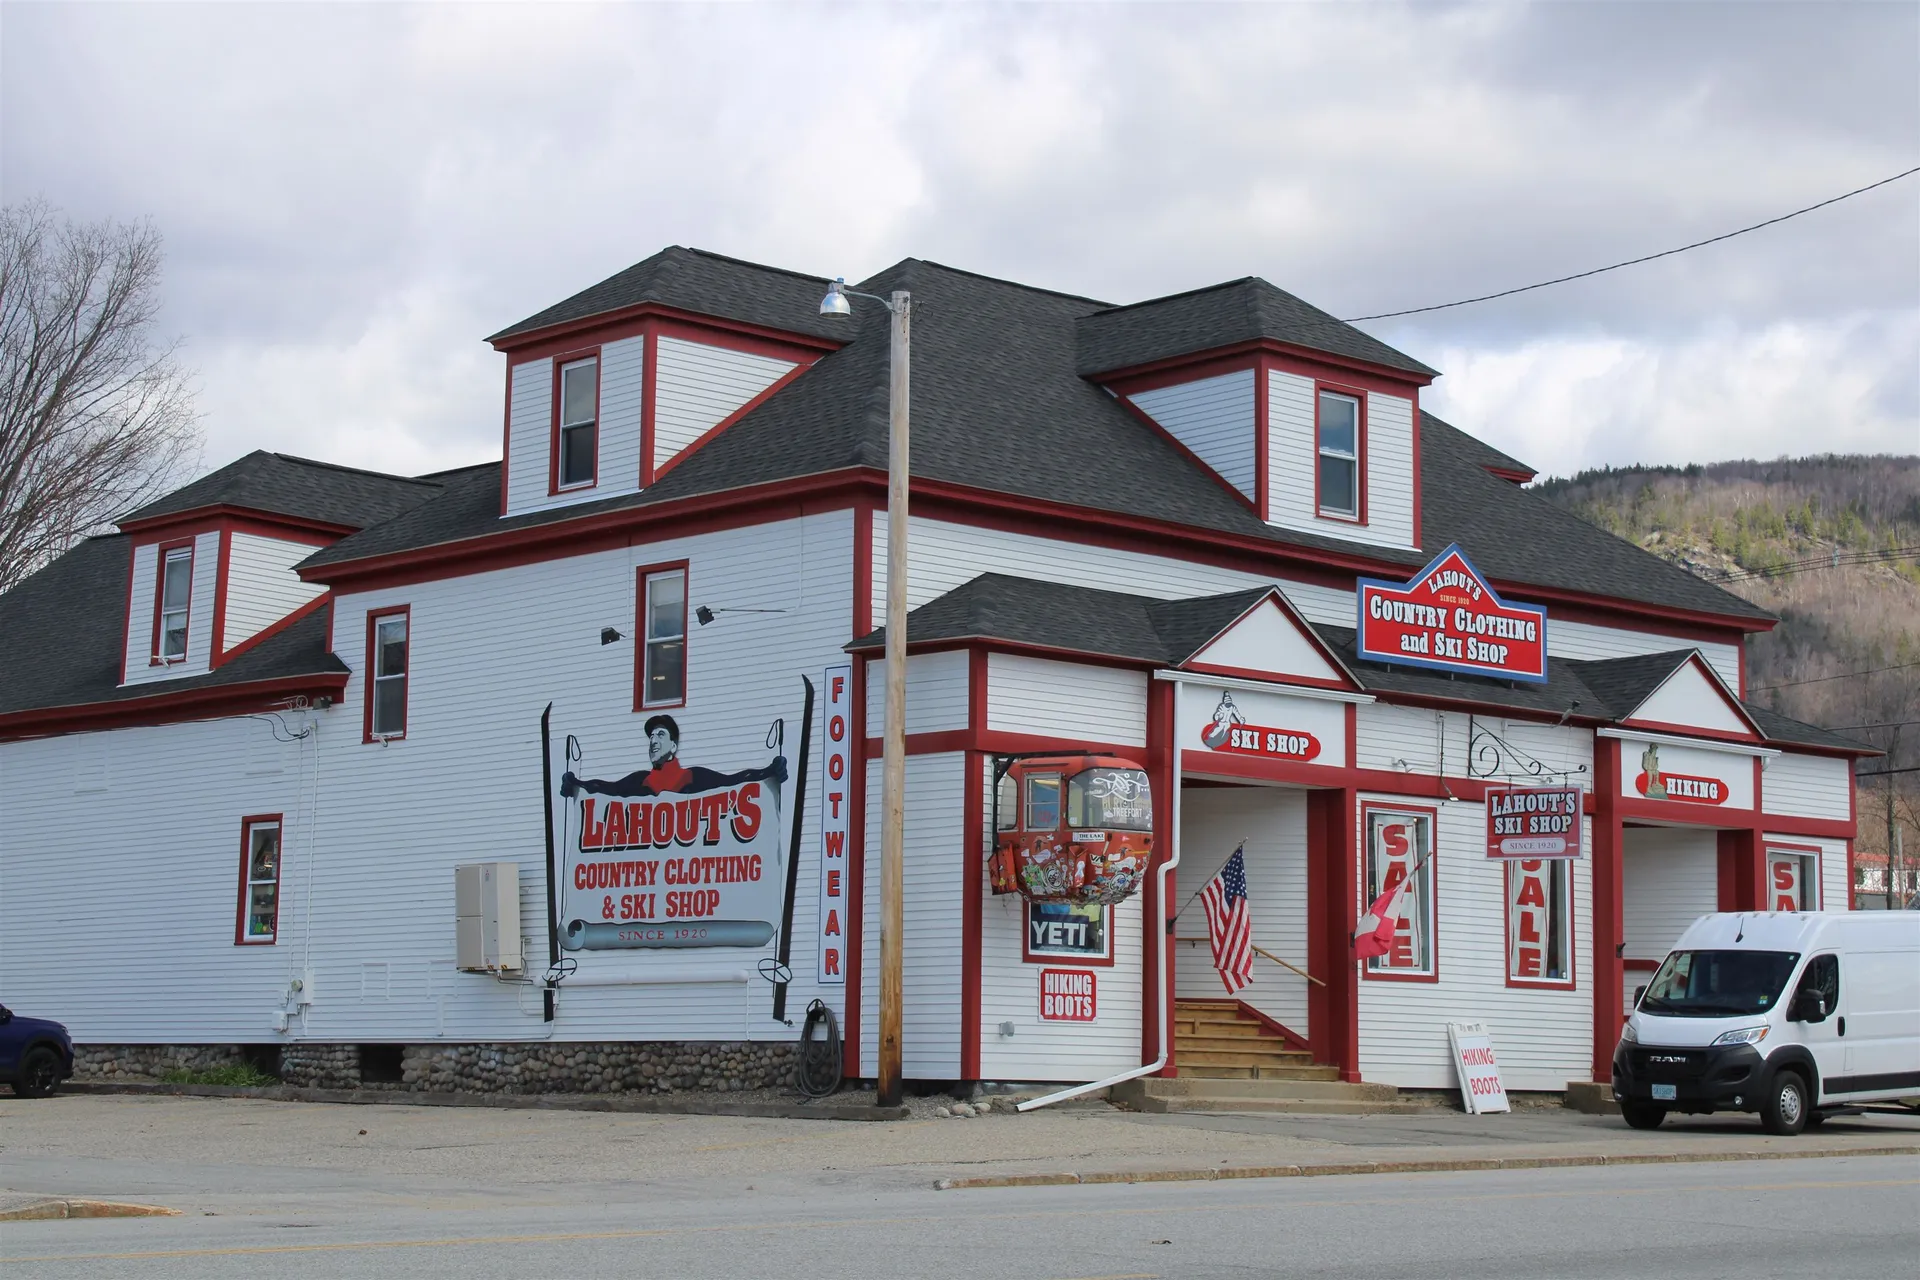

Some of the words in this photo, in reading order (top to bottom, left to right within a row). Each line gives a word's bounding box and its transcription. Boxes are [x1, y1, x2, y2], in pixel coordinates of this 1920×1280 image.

[1427, 570, 1482, 601] LAHOUT'S
[1440, 594, 1457, 603] SINCE
[1370, 595, 1447, 629] COUNTRY
[1454, 607, 1536, 642] CLOTHING
[1401, 632, 1429, 653] and
[1434, 632, 1463, 659] SKI
[1467, 637, 1508, 664] SHOP
[1231, 729, 1260, 750] SKI
[1266, 733, 1309, 755] SHOP
[1665, 777, 1718, 799] HIKING
[1491, 792, 1576, 817] LAHOUT'S
[580, 783, 762, 853] LAHOUT'S
[825, 676, 845, 976] FOOTWEAR
[1494, 817, 1523, 835] SKI
[1529, 815, 1573, 834] SHOP
[1509, 842, 1535, 850] SINCE
[1537, 841, 1557, 849] 1920
[574, 860, 659, 890] COUNTRY
[664, 854, 762, 885] CLOTHING
[602, 895, 616, 919] &
[620, 893, 656, 919] SKI
[665, 889, 720, 918] SHOP
[1383, 824, 1414, 967] SAE
[618, 930, 665, 941] SINCE
[674, 929, 708, 939] 1920
[1032, 920, 1086, 946] YETI
[1044, 973, 1092, 995] HIKING
[1044, 995, 1092, 1017] BOOTS
[1461, 1047, 1494, 1066] HIKING
[1649, 1055, 1686, 1063] RAM
[1470, 1076, 1502, 1095] BOOTS
